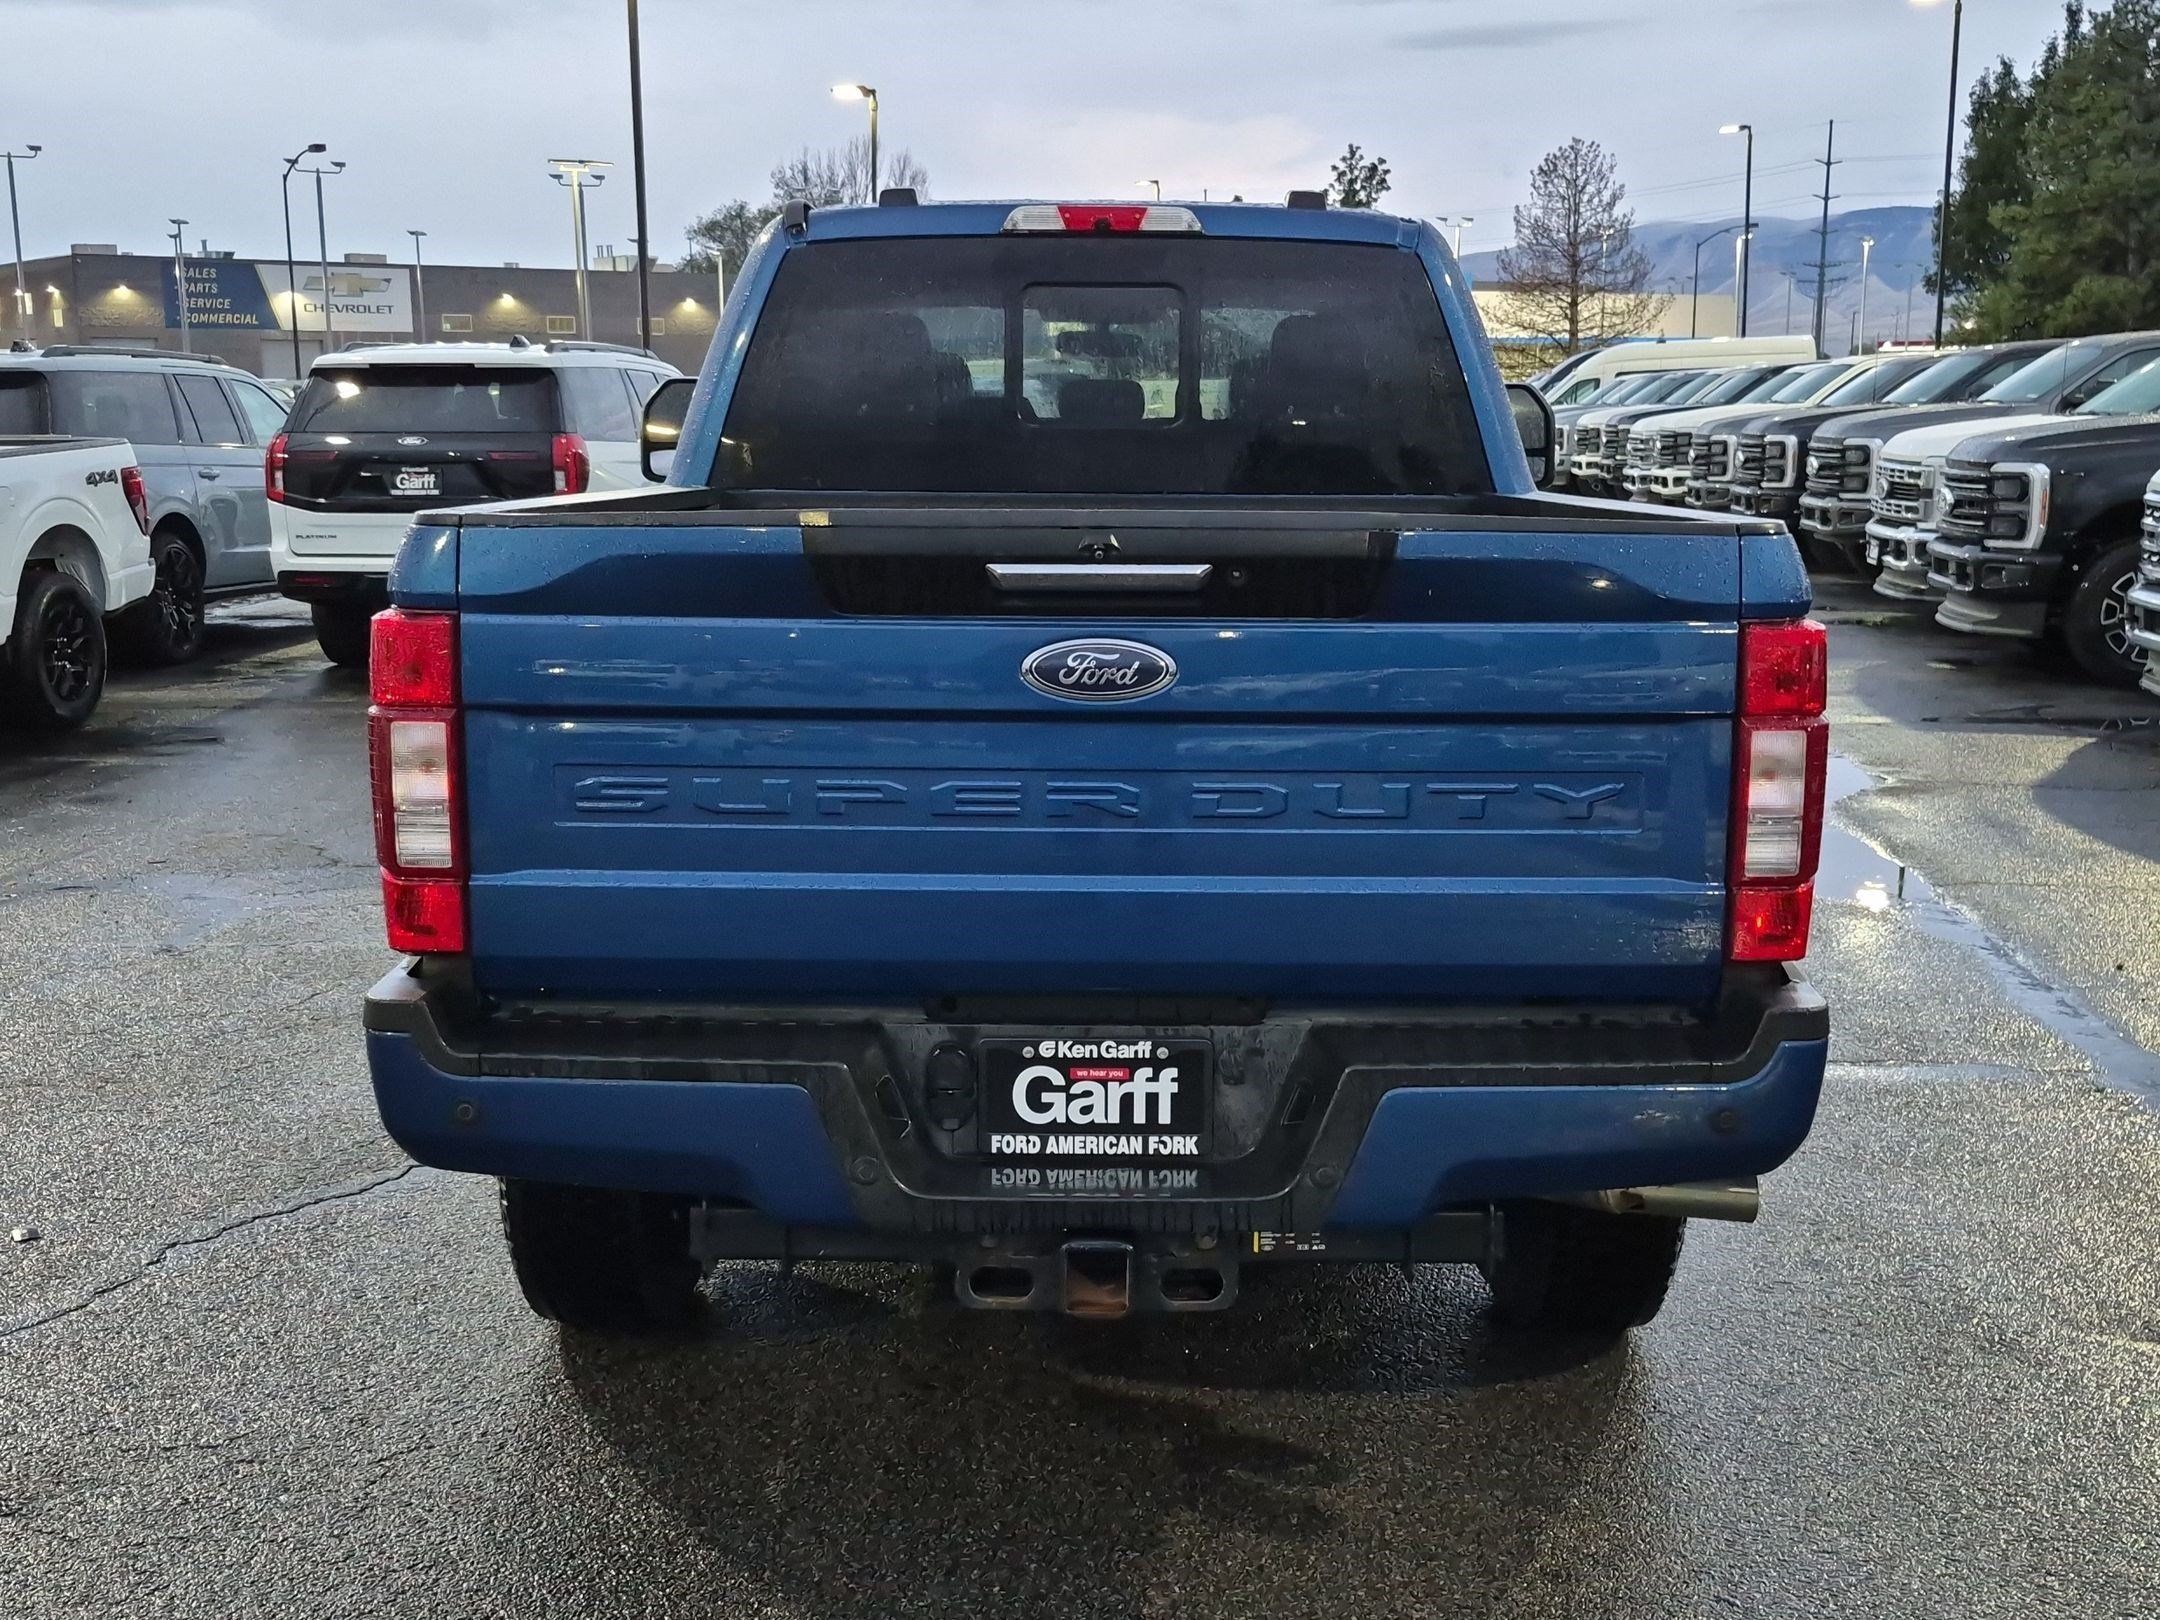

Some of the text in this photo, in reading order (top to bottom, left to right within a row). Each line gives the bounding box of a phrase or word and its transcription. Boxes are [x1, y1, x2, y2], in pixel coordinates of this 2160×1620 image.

[183, 267, 217, 279] SALES
[184, 282, 218, 294] PARTS
[184, 297, 232, 309] SERVICE
[303, 303, 394, 314] CHEVROLET
[396, 473, 436, 489] Garff
[1058, 651, 1140, 686] Ford
[575, 776, 1625, 820] SUPER DUTY
[1057, 1041, 1098, 1058] Ken
[1100, 1041, 1152, 1059] Garff
[1076, 1068, 1124, 1078] we hear you
[1012, 1065, 1179, 1125] Garff
[991, 1136, 1199, 1155] FORD AMERICAN FORK
